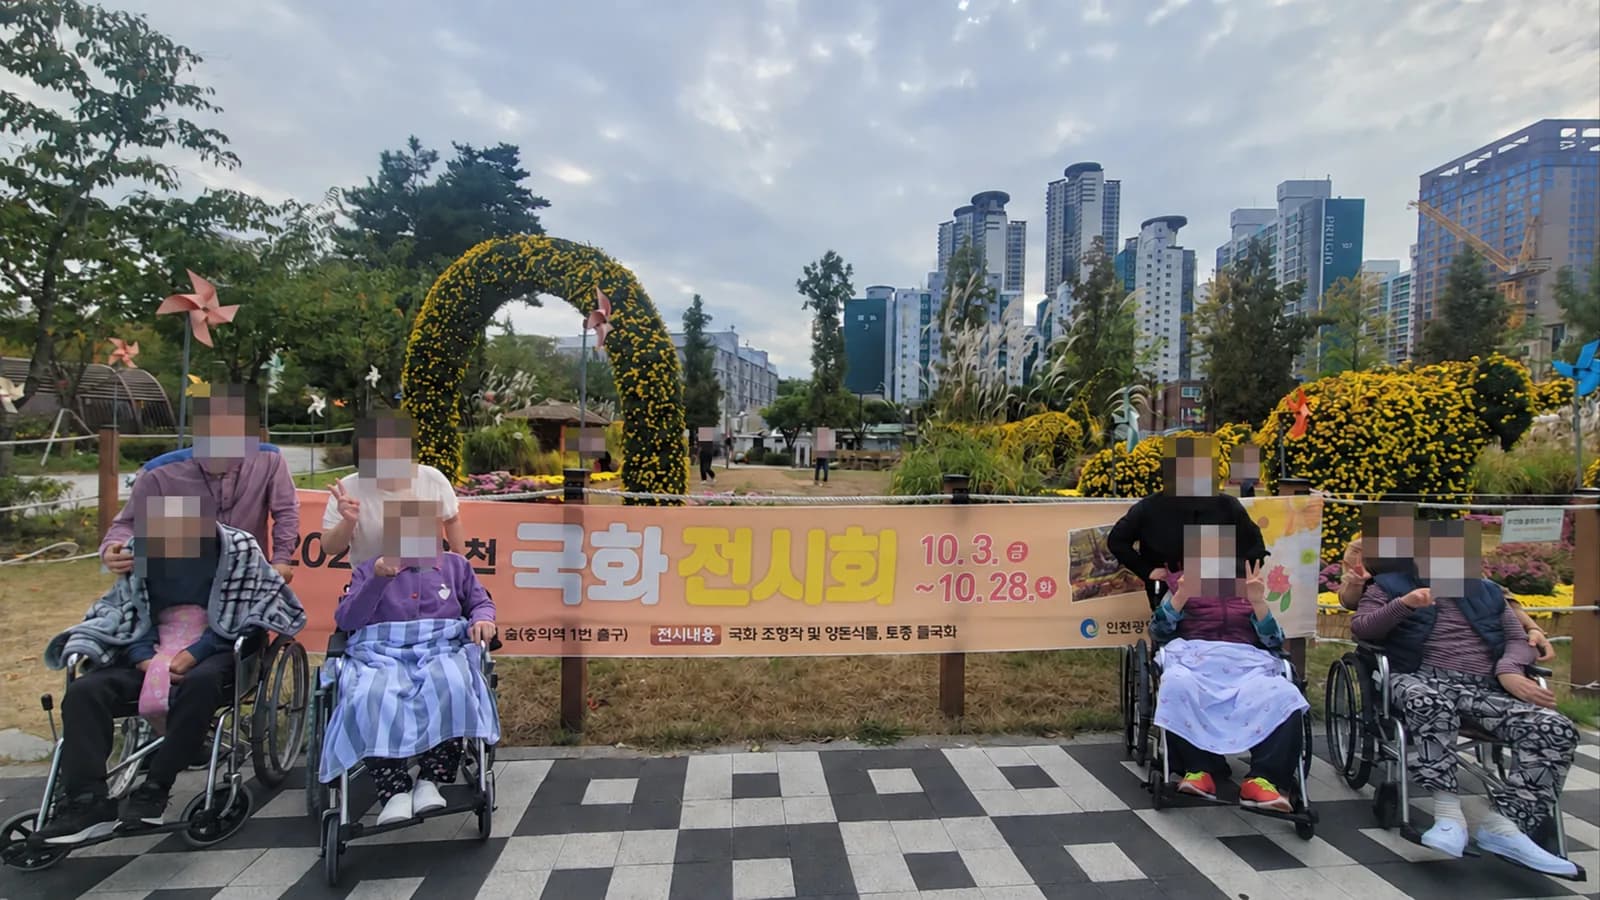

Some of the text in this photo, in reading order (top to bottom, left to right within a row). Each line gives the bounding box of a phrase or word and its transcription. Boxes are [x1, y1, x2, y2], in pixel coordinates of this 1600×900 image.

[922, 534, 964, 565] 10.
[972, 534, 998, 565] 3.
[511, 522, 669, 606] 국화
[678, 526, 897, 606] 전시회
[570, 628, 593, 641] 1번
[597, 627, 628, 641] 출구)
[657, 626, 716, 643] 전시내용
[728, 627, 758, 641] 국화
[761, 626, 803, 642] 조형작
[807, 626, 821, 641] 및
[886, 625, 912, 640] 토종
[917, 624, 957, 640] 들국화
[1106, 620, 1151, 635] 인천광
